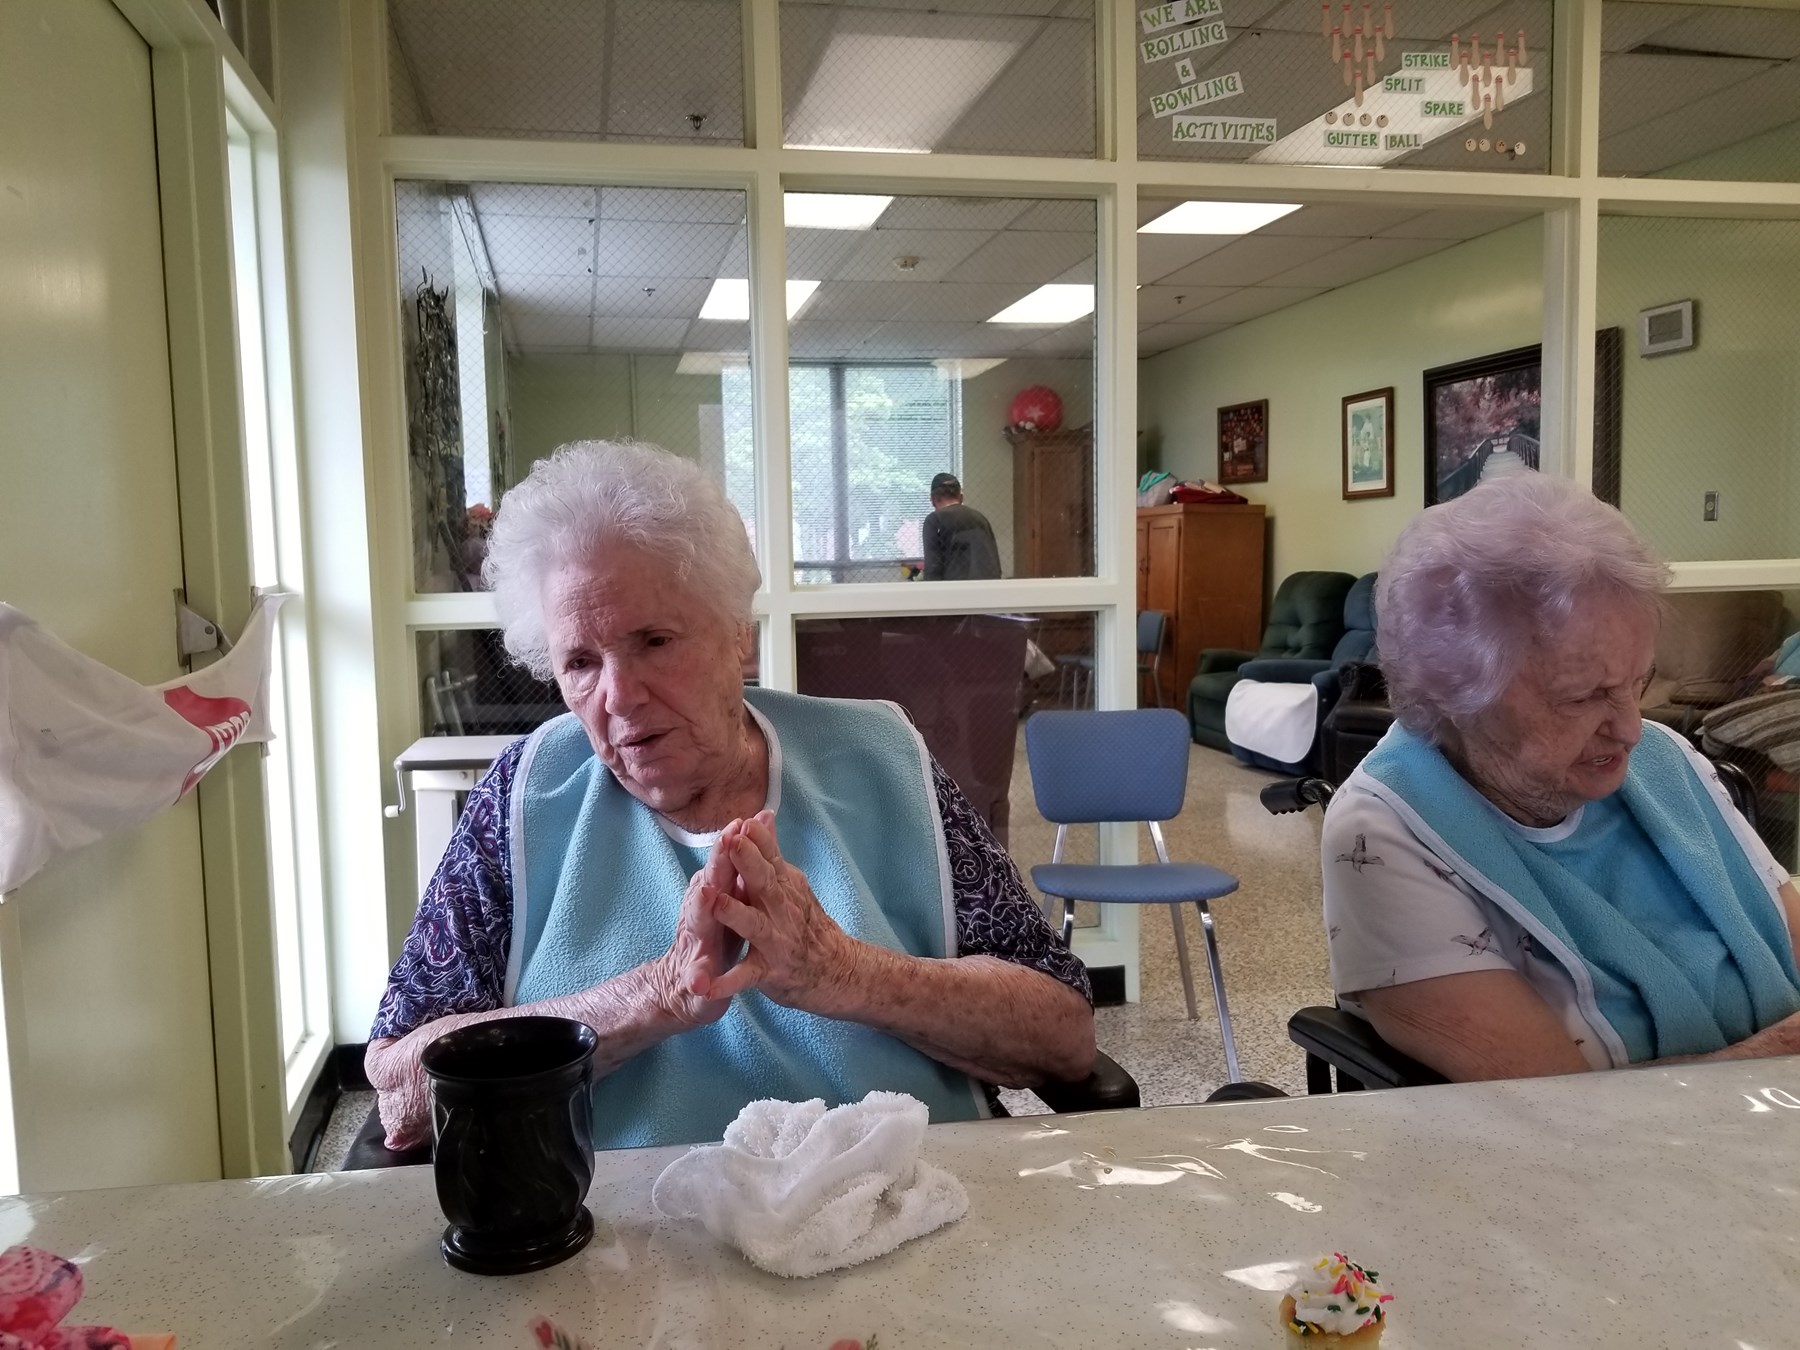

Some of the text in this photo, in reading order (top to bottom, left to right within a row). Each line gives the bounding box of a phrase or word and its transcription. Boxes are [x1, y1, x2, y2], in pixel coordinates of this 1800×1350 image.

[1143, 0, 1219, 28] WE ARE
[1143, 23, 1225, 60] ROLLING
[1404, 54, 1449, 67] STRIKE
[1180, 64, 1191, 78] &
[1384, 78, 1423, 91] SPLIT
[1152, 75, 1238, 114] BOWLING
[1424, 101, 1463, 116] SPARE
[1327, 132, 1420, 148] GUTTER BALL
